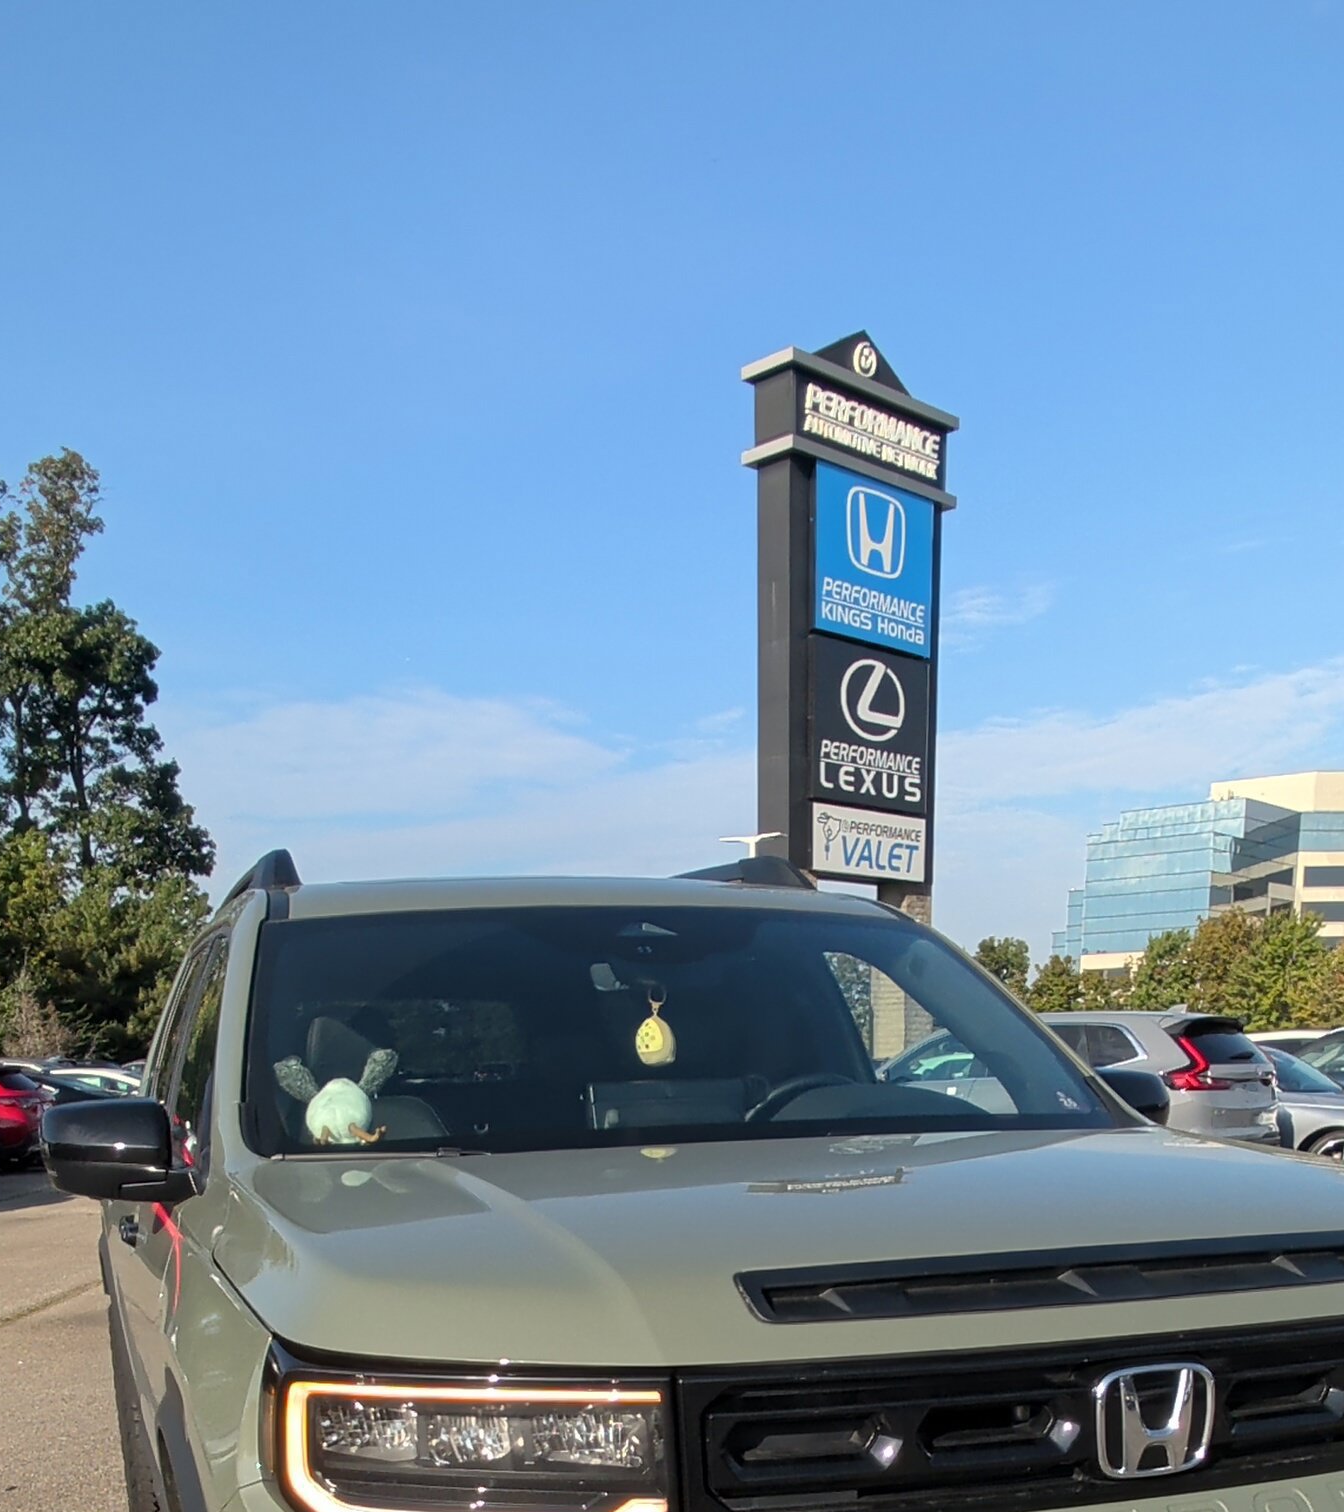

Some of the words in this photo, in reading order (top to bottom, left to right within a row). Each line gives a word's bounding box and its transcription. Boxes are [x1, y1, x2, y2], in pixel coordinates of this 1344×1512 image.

[803, 414, 881, 457] AUTOMOTIVE
[805, 382, 941, 458] PERFORMANCE
[822, 577, 925, 623] PERFORMANCE
[821, 600, 872, 631] KINGS
[877, 617, 924, 645] Honda
[820, 739, 921, 775] PERFORMANCE
[819, 761, 921, 802] LEXUS
[850, 821, 922, 842] PERFORMANCE
[841, 835, 919, 873] VALET
